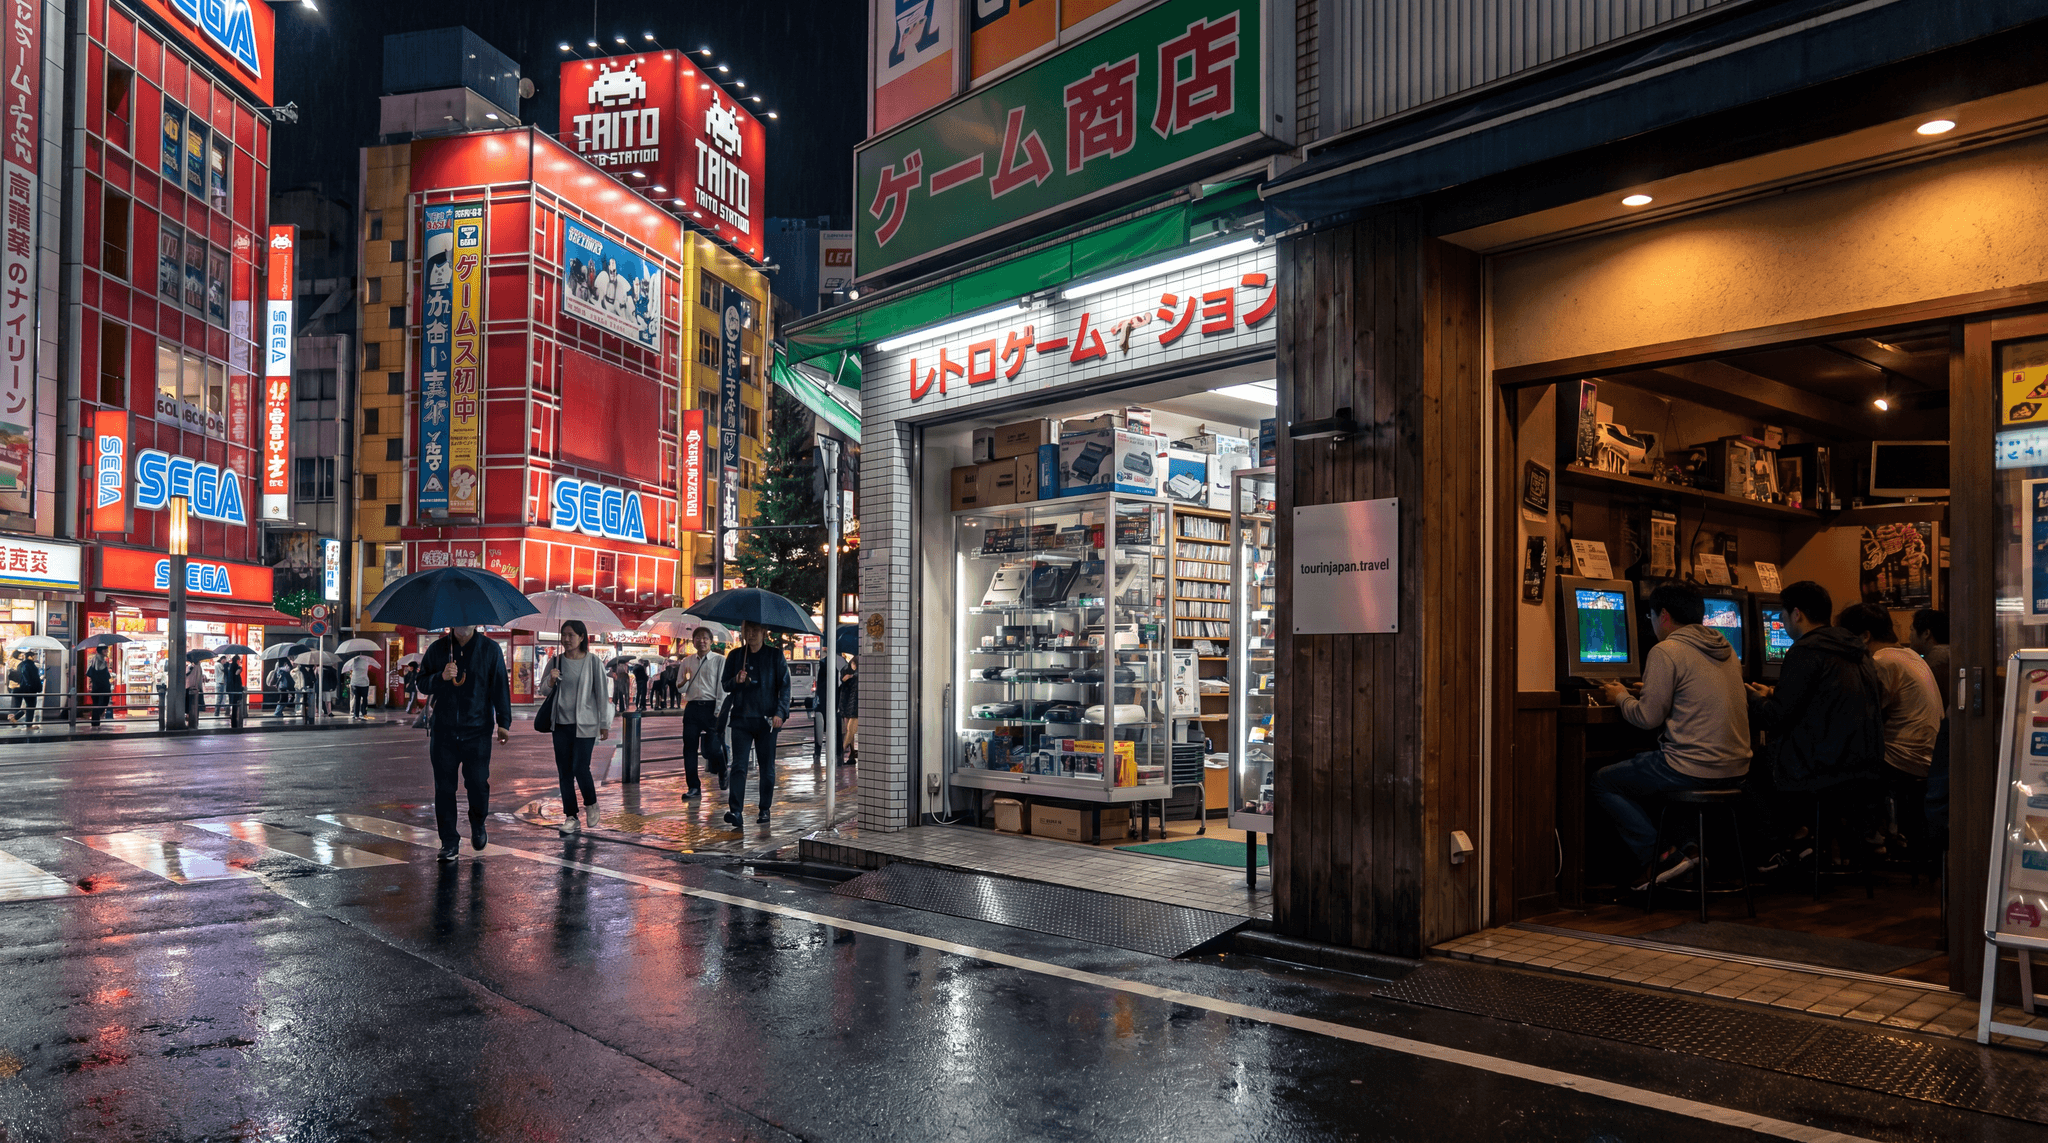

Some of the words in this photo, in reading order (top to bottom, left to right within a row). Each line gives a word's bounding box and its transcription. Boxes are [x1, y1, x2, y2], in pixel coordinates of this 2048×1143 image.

[171, 0, 261, 79] GA
[573, 107, 660, 152] TAITO
[869, 10, 1240, 248] ゲーム商店
[694, 138, 750, 216] TAITO
[453, 254, 479, 424] ゲームス初中
[97, 435, 123, 509] SEGA
[134, 448, 247, 527] SEGA
[550, 475, 648, 544] SEGA
[153, 558, 233, 596] SEGA
[1300, 557, 1390, 576] tourinjapan.travel
